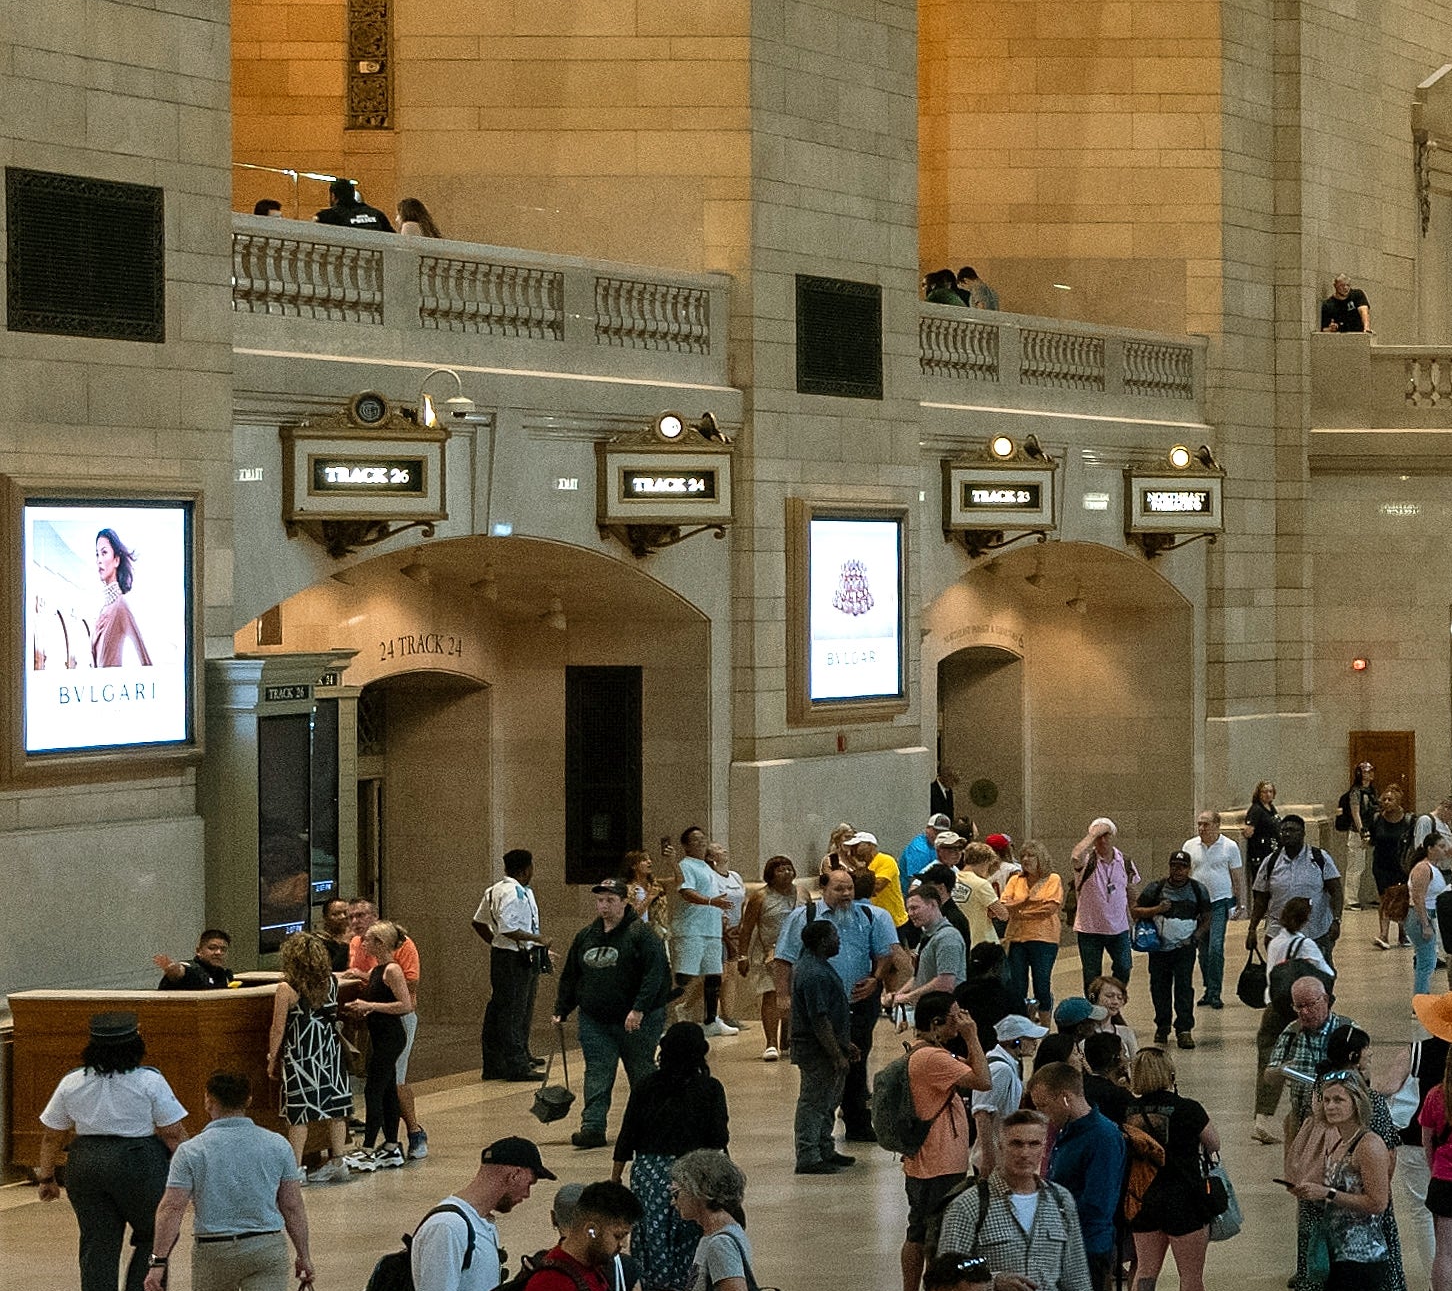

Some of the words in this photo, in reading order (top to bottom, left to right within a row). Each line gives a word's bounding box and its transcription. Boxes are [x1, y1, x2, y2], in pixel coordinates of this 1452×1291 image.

[324, 466, 389, 484] TRACK
[390, 467, 410, 484] 26
[632, 476, 688, 492] TRACK
[688, 477, 706, 492] 24
[971, 489, 1018, 503] TRACK
[1147, 490, 1207, 503] NORTHEAST
[379, 641, 395, 661] 24
[397, 632, 444, 657] TRACK
[447, 636, 463, 658] 24
[59, 682, 155, 704] BVLGARI
[268, 686, 294, 700] TRACK
[295, 686, 305, 699] 26
